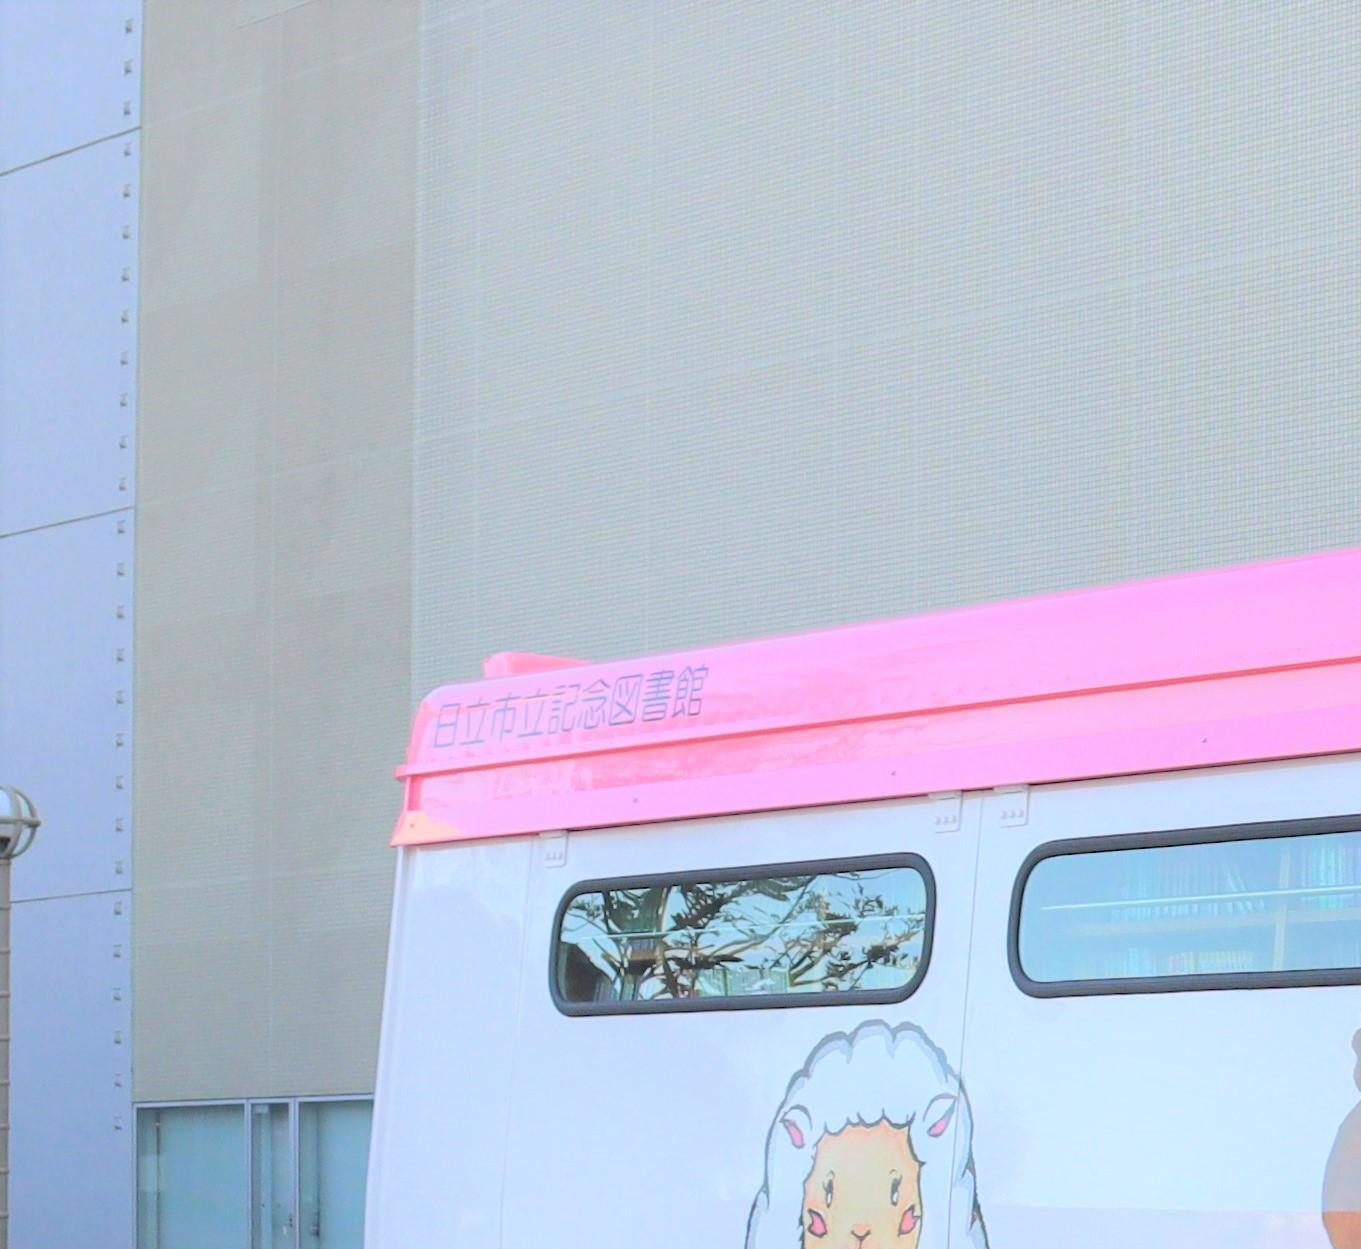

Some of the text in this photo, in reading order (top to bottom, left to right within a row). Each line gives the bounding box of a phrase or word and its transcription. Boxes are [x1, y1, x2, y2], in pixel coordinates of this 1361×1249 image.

[434, 664, 709, 748] 日立市立記念図書館
